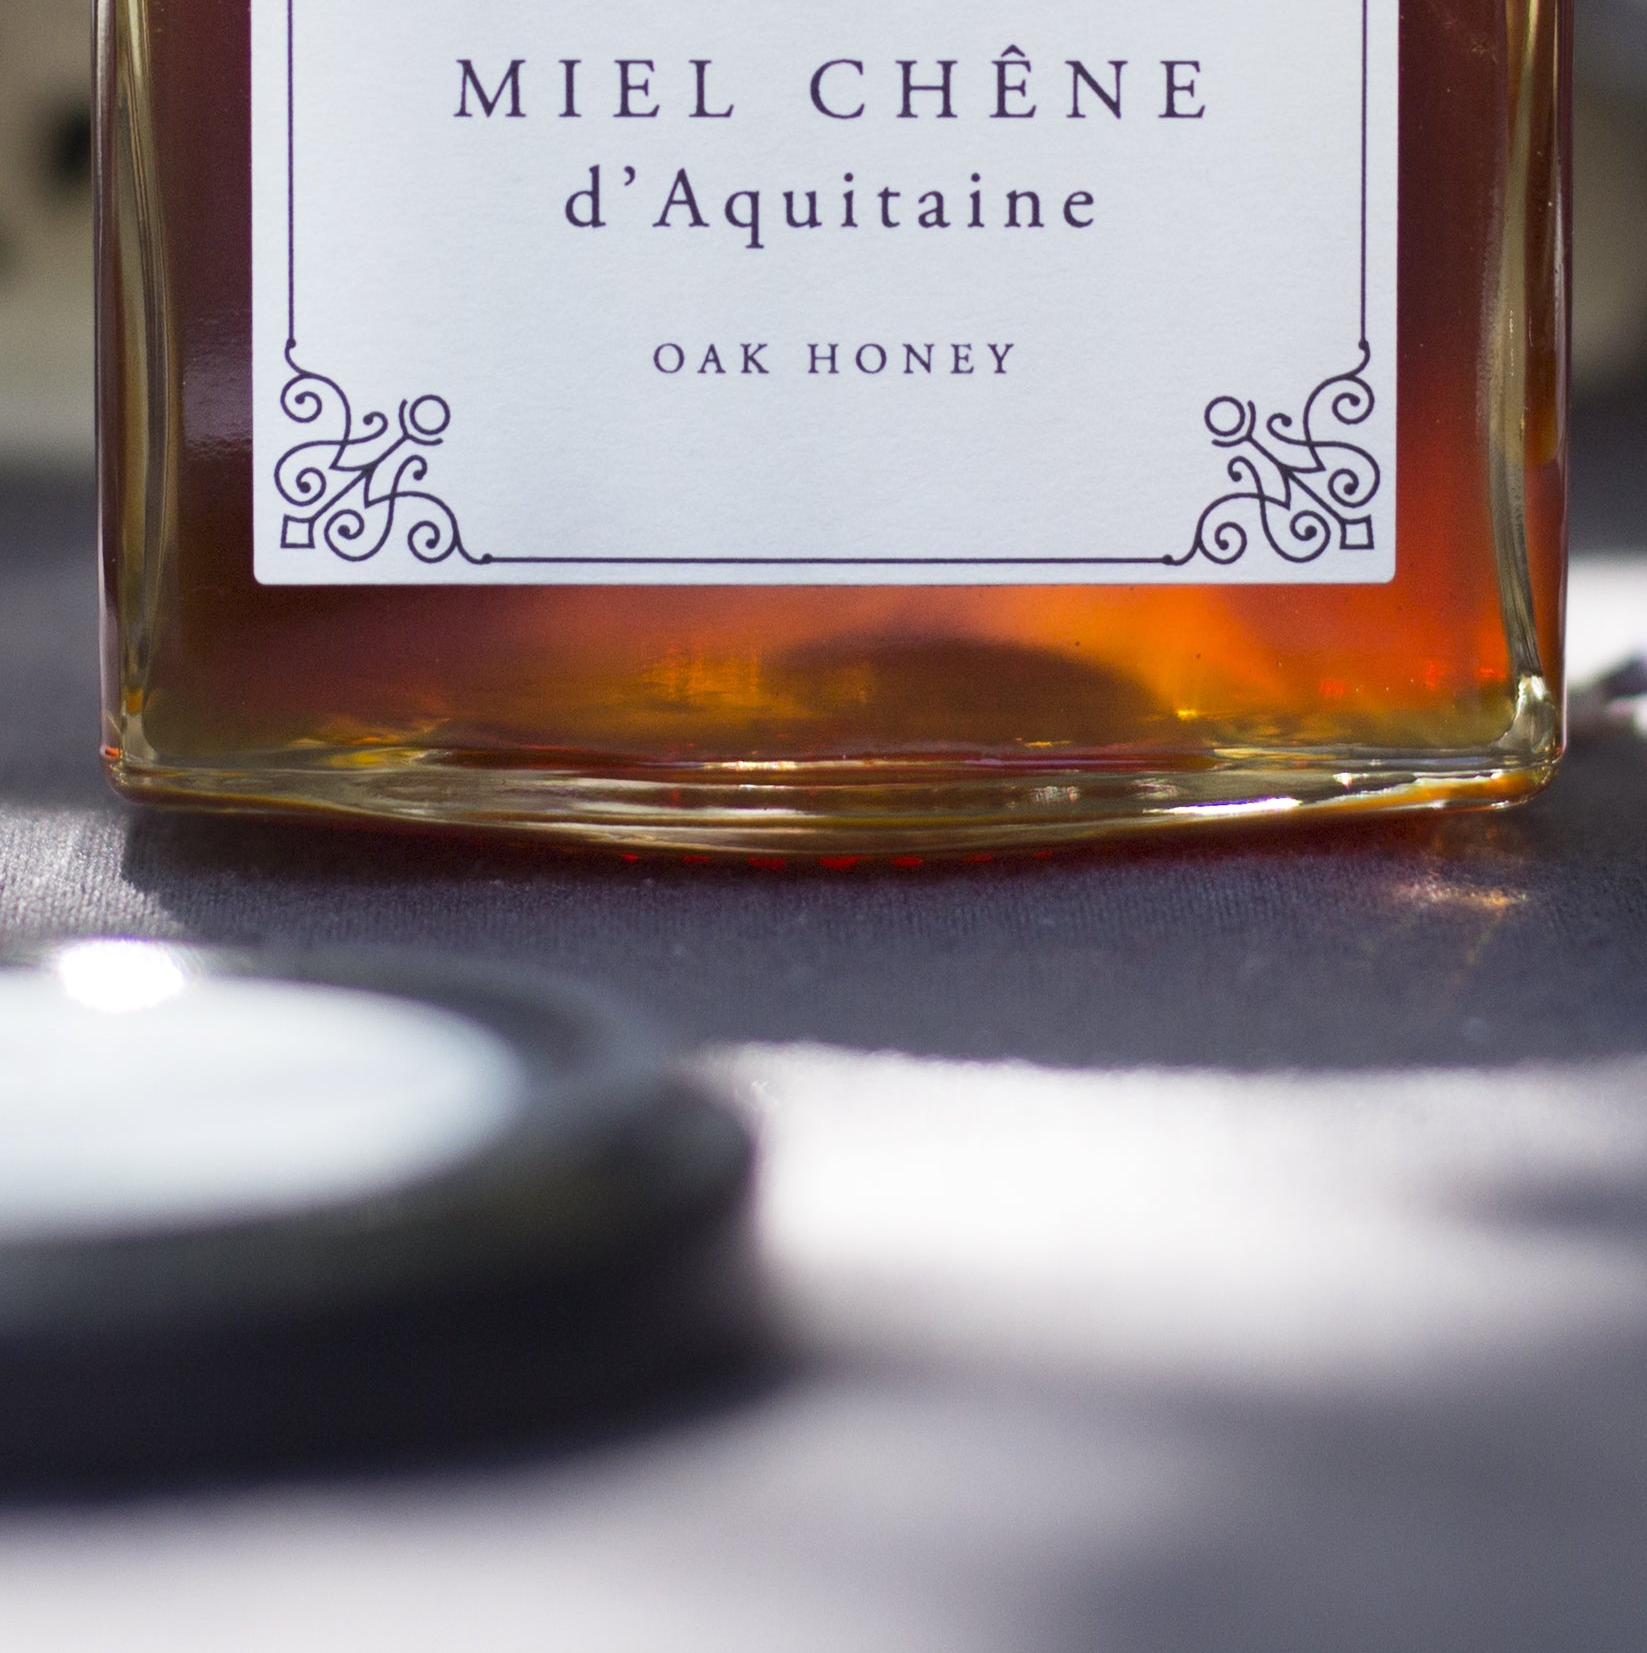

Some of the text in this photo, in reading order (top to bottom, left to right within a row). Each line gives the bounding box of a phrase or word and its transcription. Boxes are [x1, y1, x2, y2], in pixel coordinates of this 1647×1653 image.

[453, 43, 1207, 121] MIEL CHÊNE
[651, 342, 1016, 375] OAK HONEY
